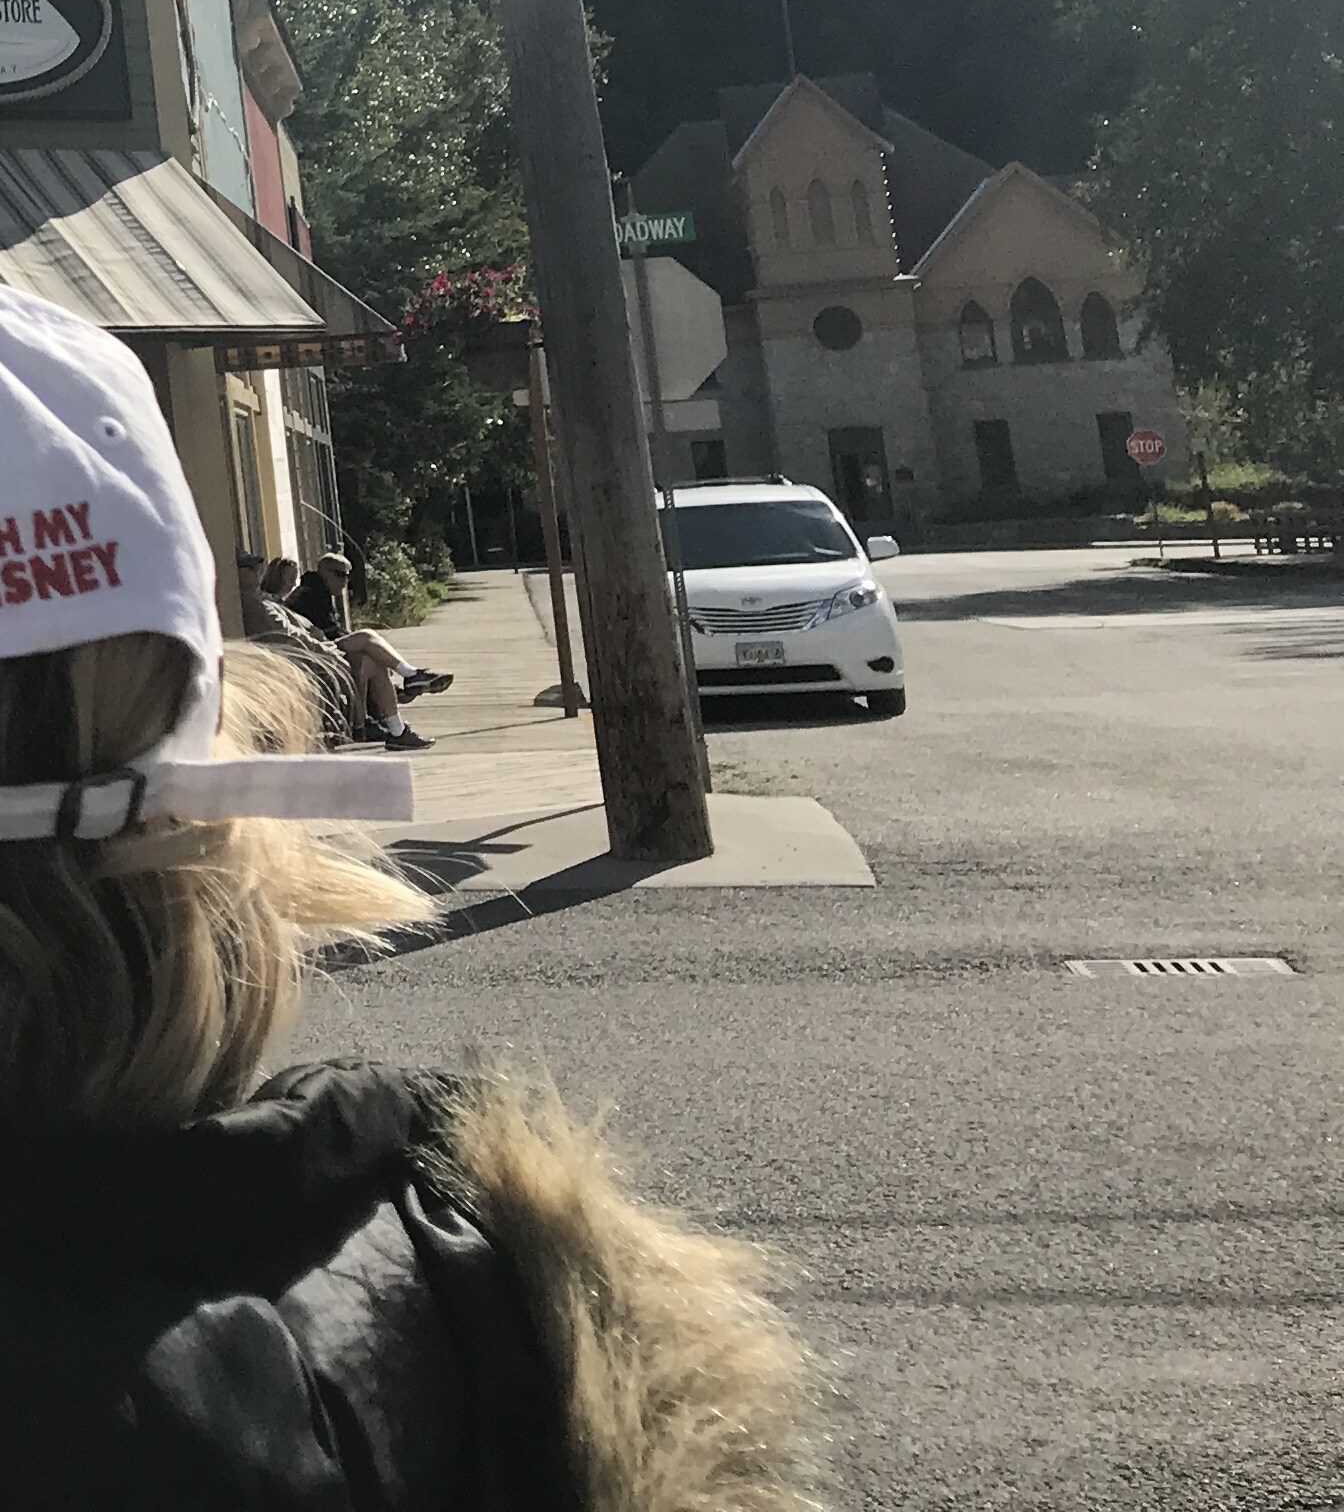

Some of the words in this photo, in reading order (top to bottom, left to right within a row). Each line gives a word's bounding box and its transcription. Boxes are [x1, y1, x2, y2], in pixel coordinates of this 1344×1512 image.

[615, 216, 686, 243] OADWAY
[1130, 439, 1163, 454] STOP
[32, 500, 93, 549] MY
